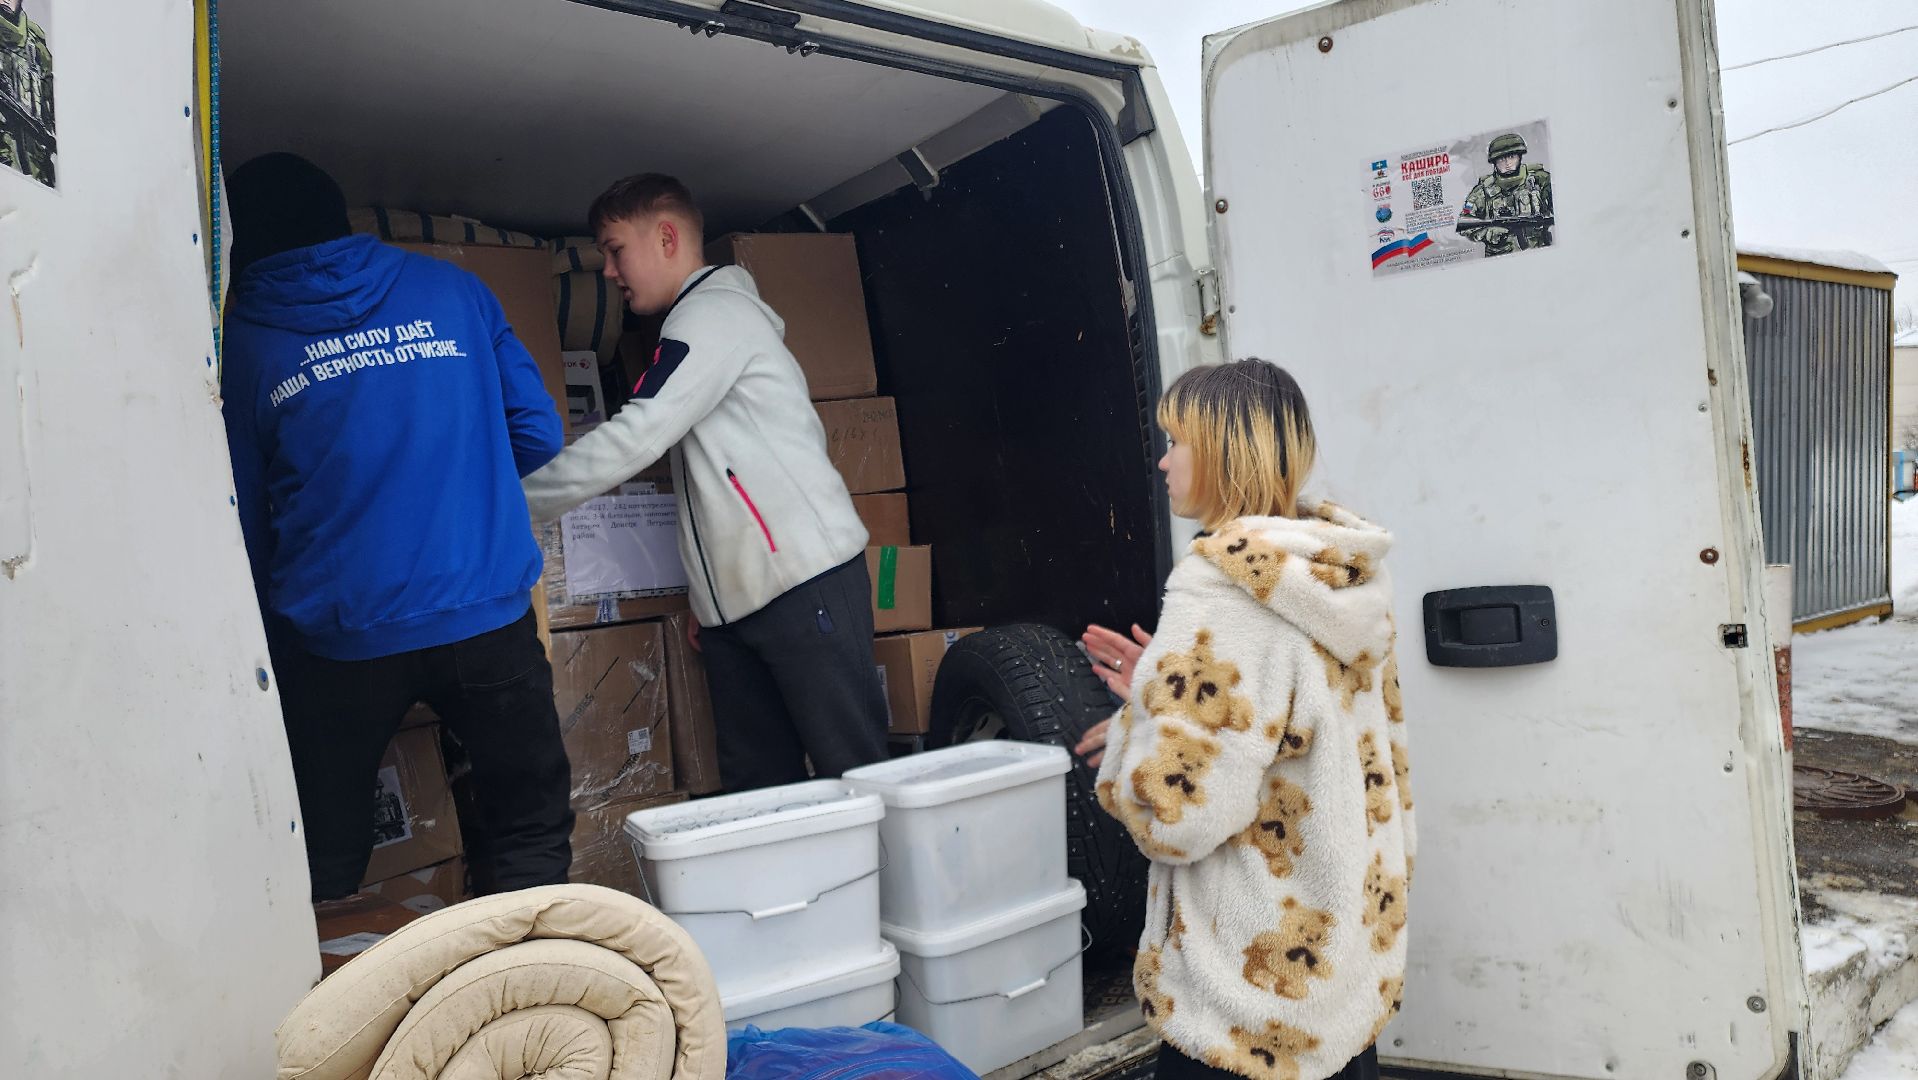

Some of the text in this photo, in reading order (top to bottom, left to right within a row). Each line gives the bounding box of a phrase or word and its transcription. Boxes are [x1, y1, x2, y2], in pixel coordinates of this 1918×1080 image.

[1401, 153, 1450, 174] КАШИРА
[344, 327, 391, 350] СИЛУ
[395, 319, 436, 343] ДАЁТ
[269, 372, 310, 407] НАША
[311, 349, 395, 382] ВЕРНОСТЬ
